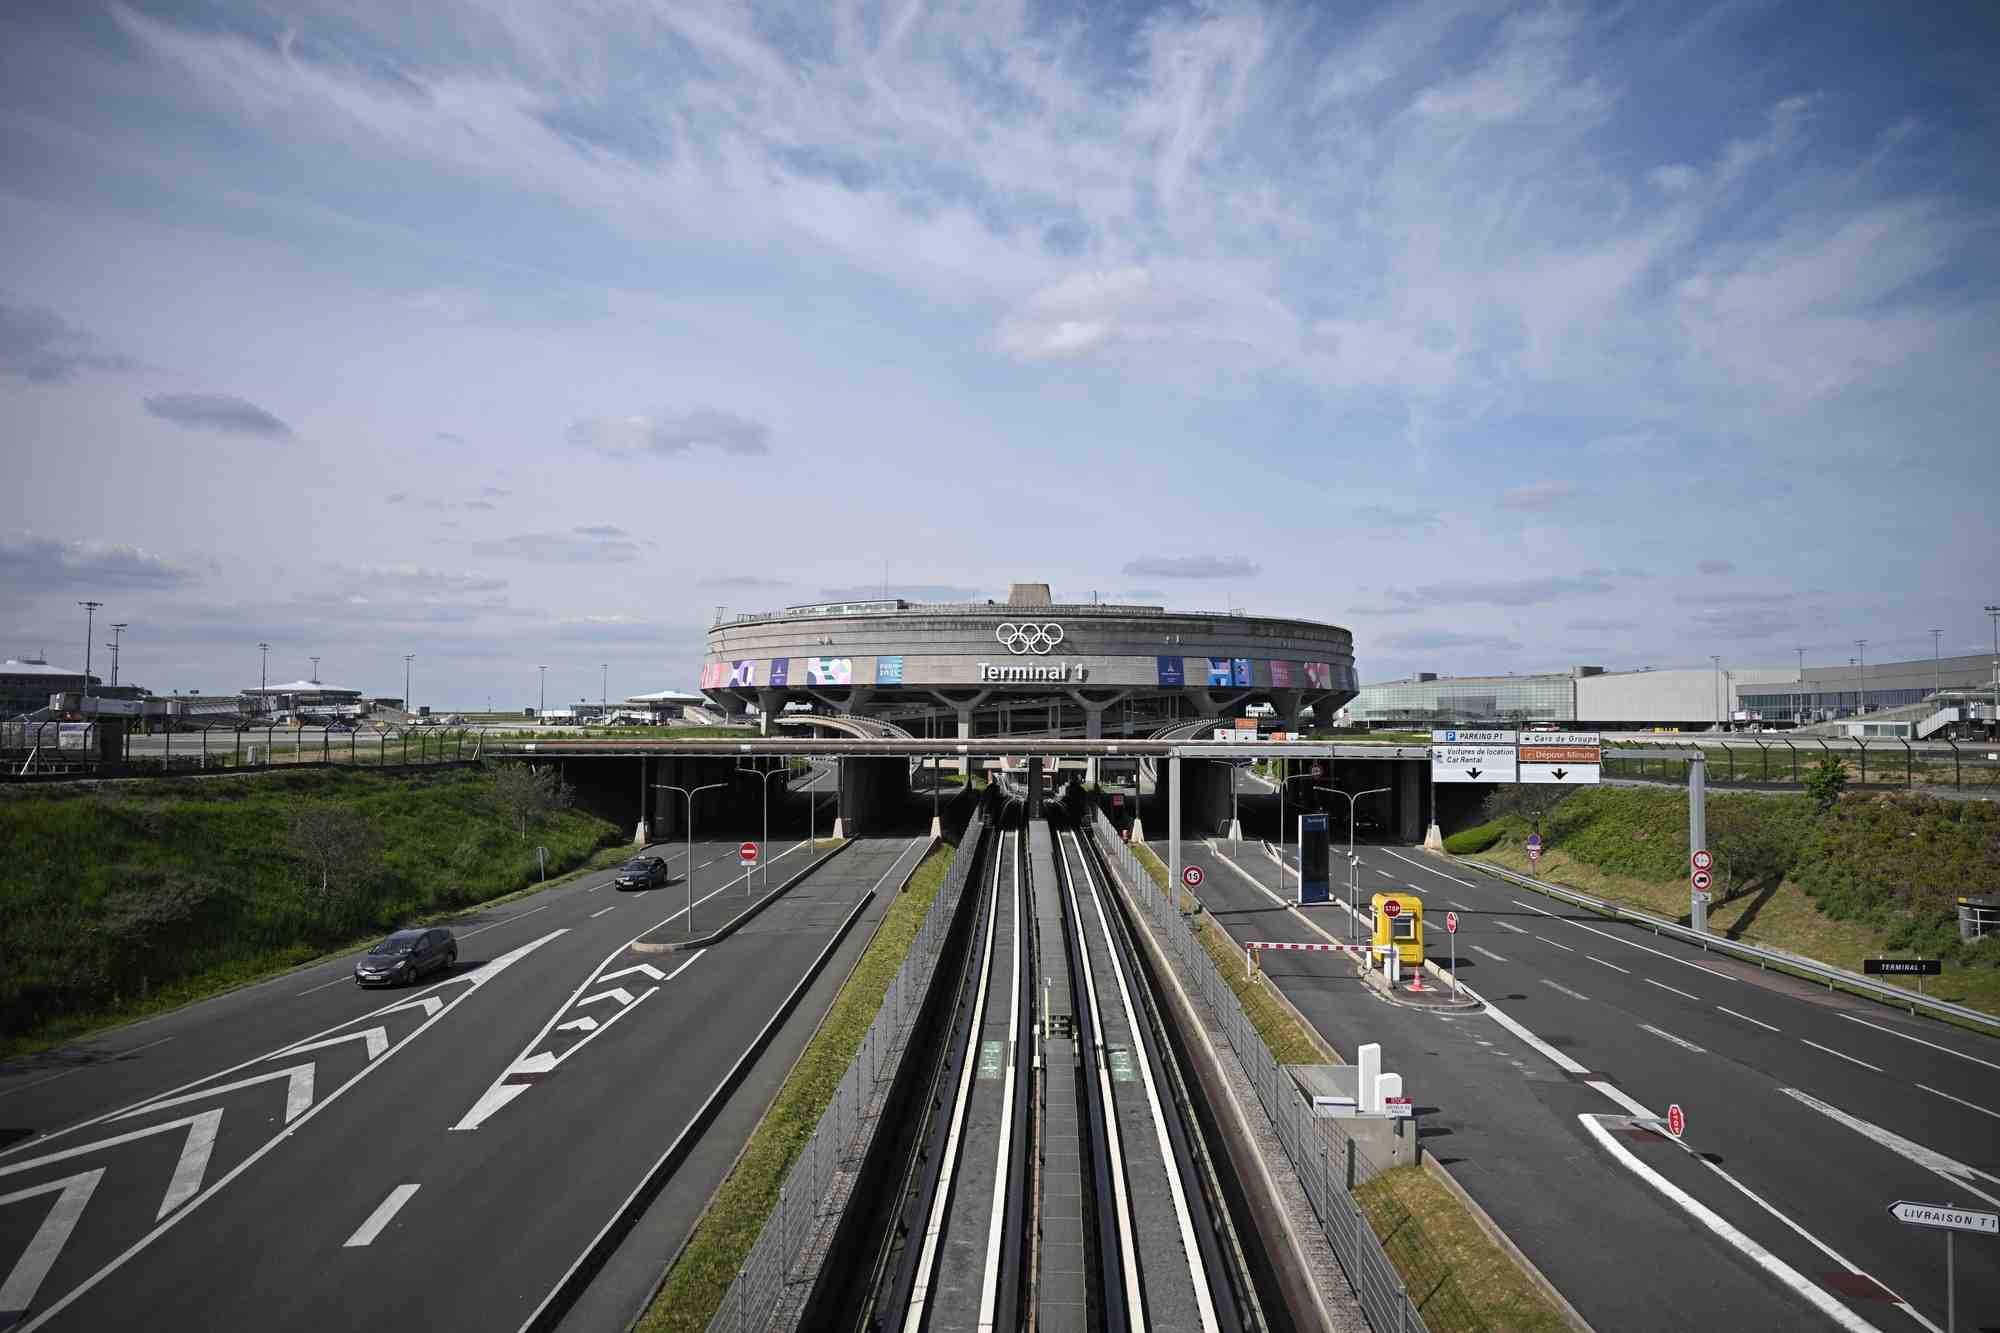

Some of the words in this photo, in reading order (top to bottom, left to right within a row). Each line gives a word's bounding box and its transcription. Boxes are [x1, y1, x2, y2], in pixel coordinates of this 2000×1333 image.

[977, 662, 1066, 680] Terminal
[1074, 663, 1084, 680] 1
[1447, 748, 1475, 756] Voitures
[1486, 748, 1514, 756] location
[1189, 872, 1198, 880] 15
[1881, 963, 1918, 971] TERMINAL
[1903, 1208, 1973, 1225] LIVRAISON
